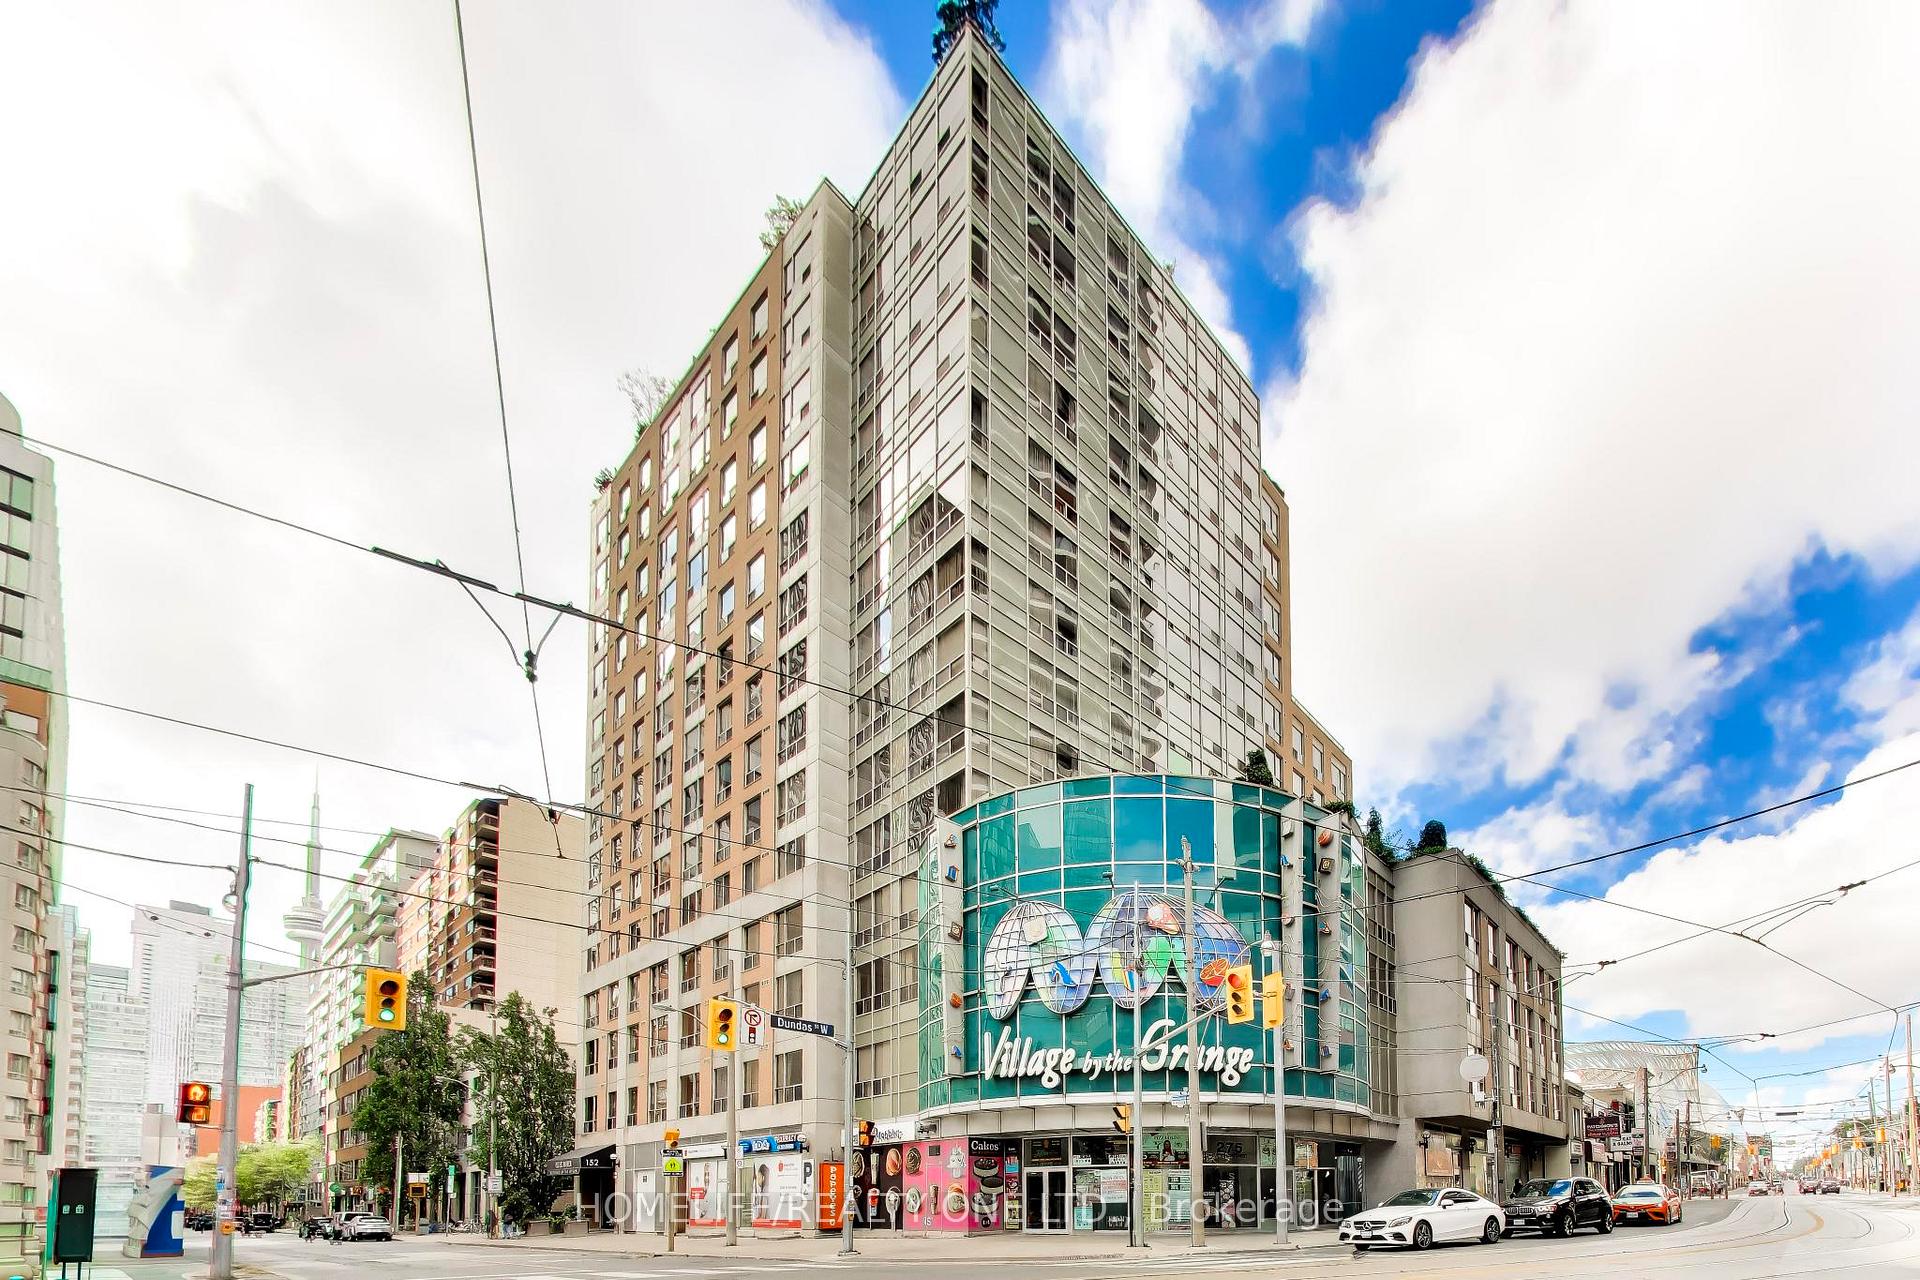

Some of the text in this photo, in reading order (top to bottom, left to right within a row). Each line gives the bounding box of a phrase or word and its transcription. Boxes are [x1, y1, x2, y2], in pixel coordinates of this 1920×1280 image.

[777, 1017, 813, 1032] Dundas
[820, 1024, 829, 1035] W
[984, 1025, 1076, 1088] Village
[1082, 1050, 1102, 1081] by
[1104, 1049, 1133, 1072] the
[971, 1140, 999, 1151] Cakes
[585, 1158, 599, 1167] 152
